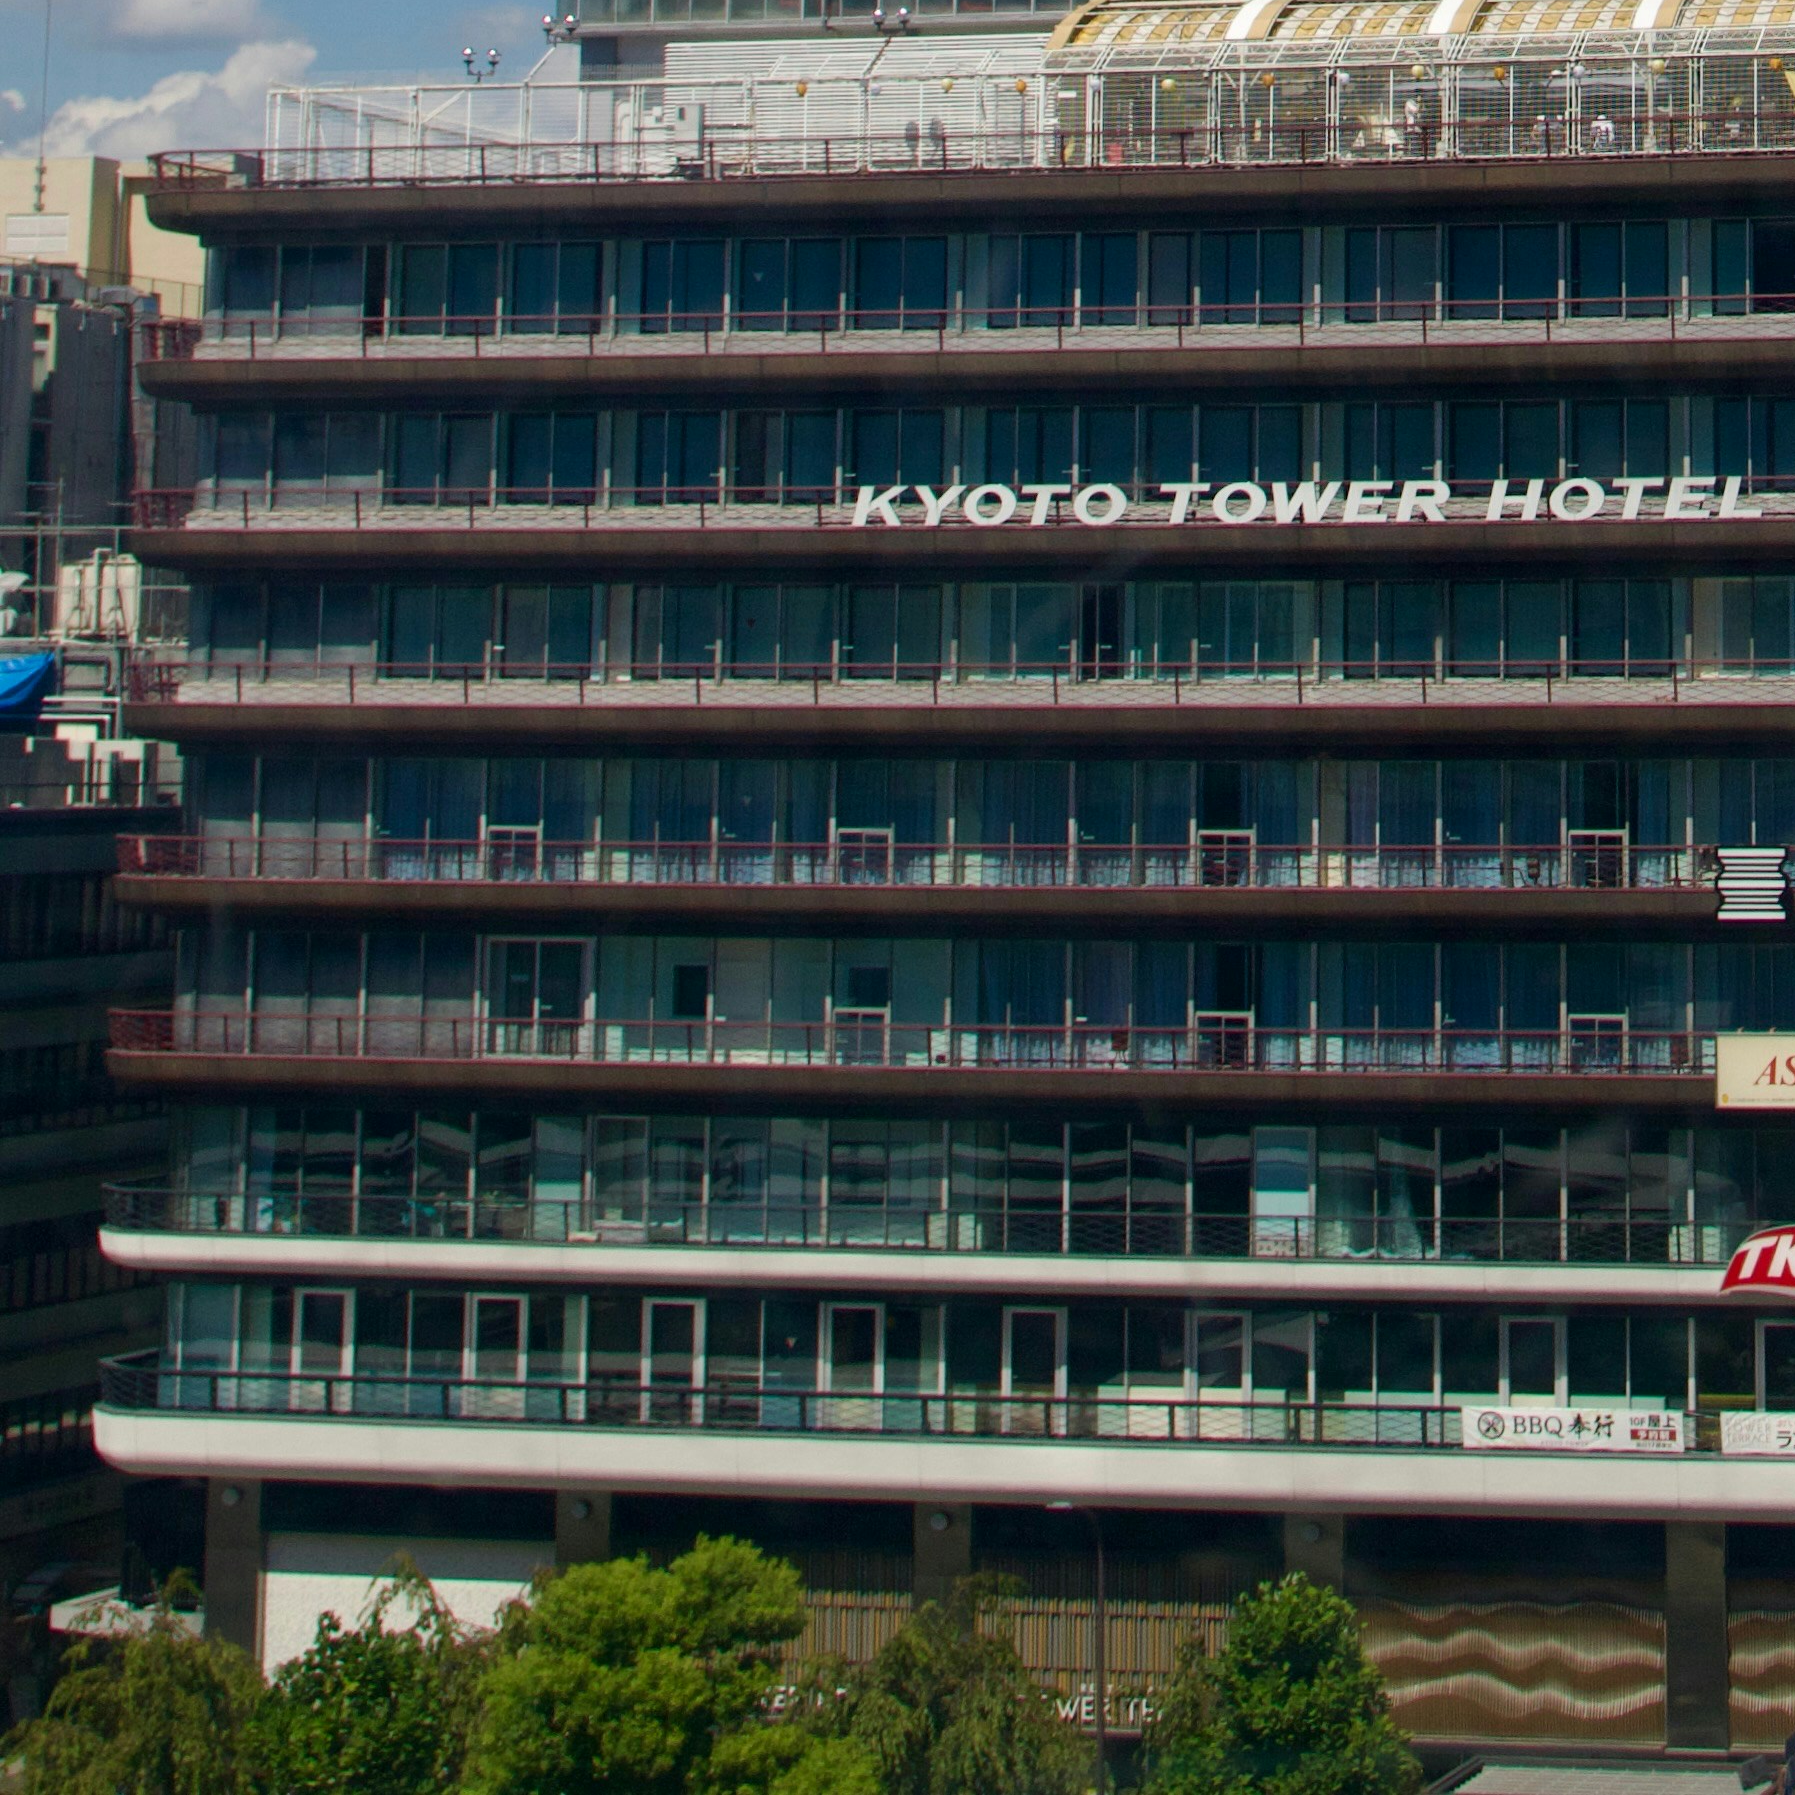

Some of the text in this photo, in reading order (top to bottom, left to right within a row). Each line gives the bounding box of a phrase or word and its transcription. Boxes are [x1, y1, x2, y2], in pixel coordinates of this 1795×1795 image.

[851, 475, 1766, 528] KYOTO TOWER HOTEL
[1512, 1412, 1615, 1439] BBQ 奉行
[1629, 1416, 1646, 1427] 10F
